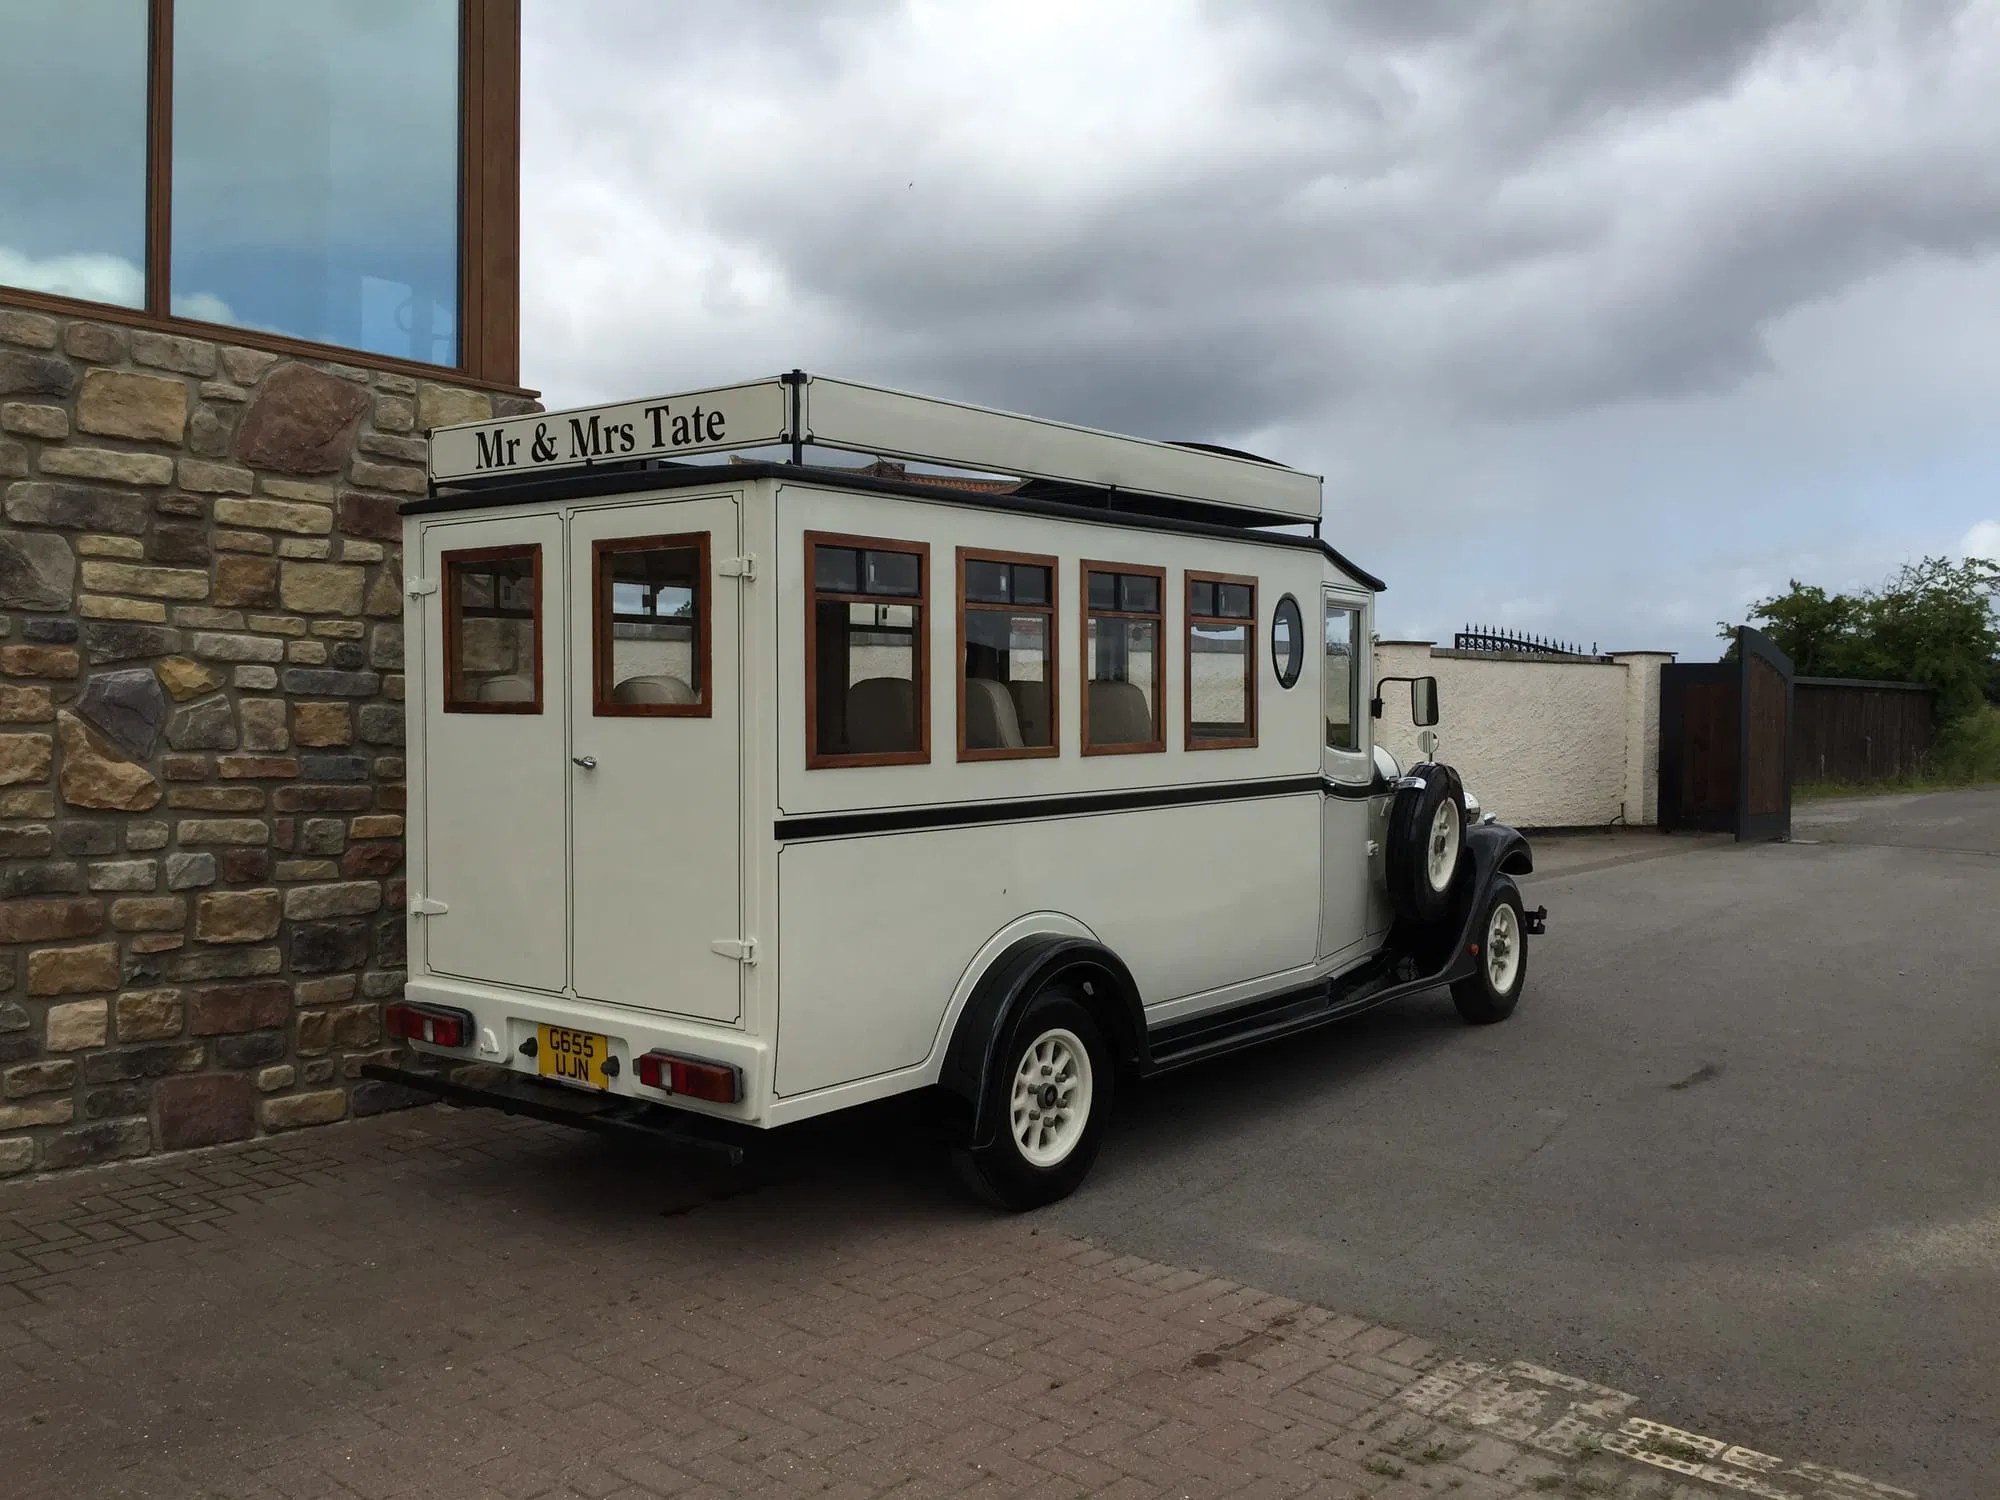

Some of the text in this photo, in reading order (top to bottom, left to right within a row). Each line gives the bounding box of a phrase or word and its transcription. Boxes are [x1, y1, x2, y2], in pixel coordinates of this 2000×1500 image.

[475, 404, 726, 470] Mr & Mrs Tate
[549, 1027, 594, 1058] G655
[555, 1053, 589, 1081] UJN
